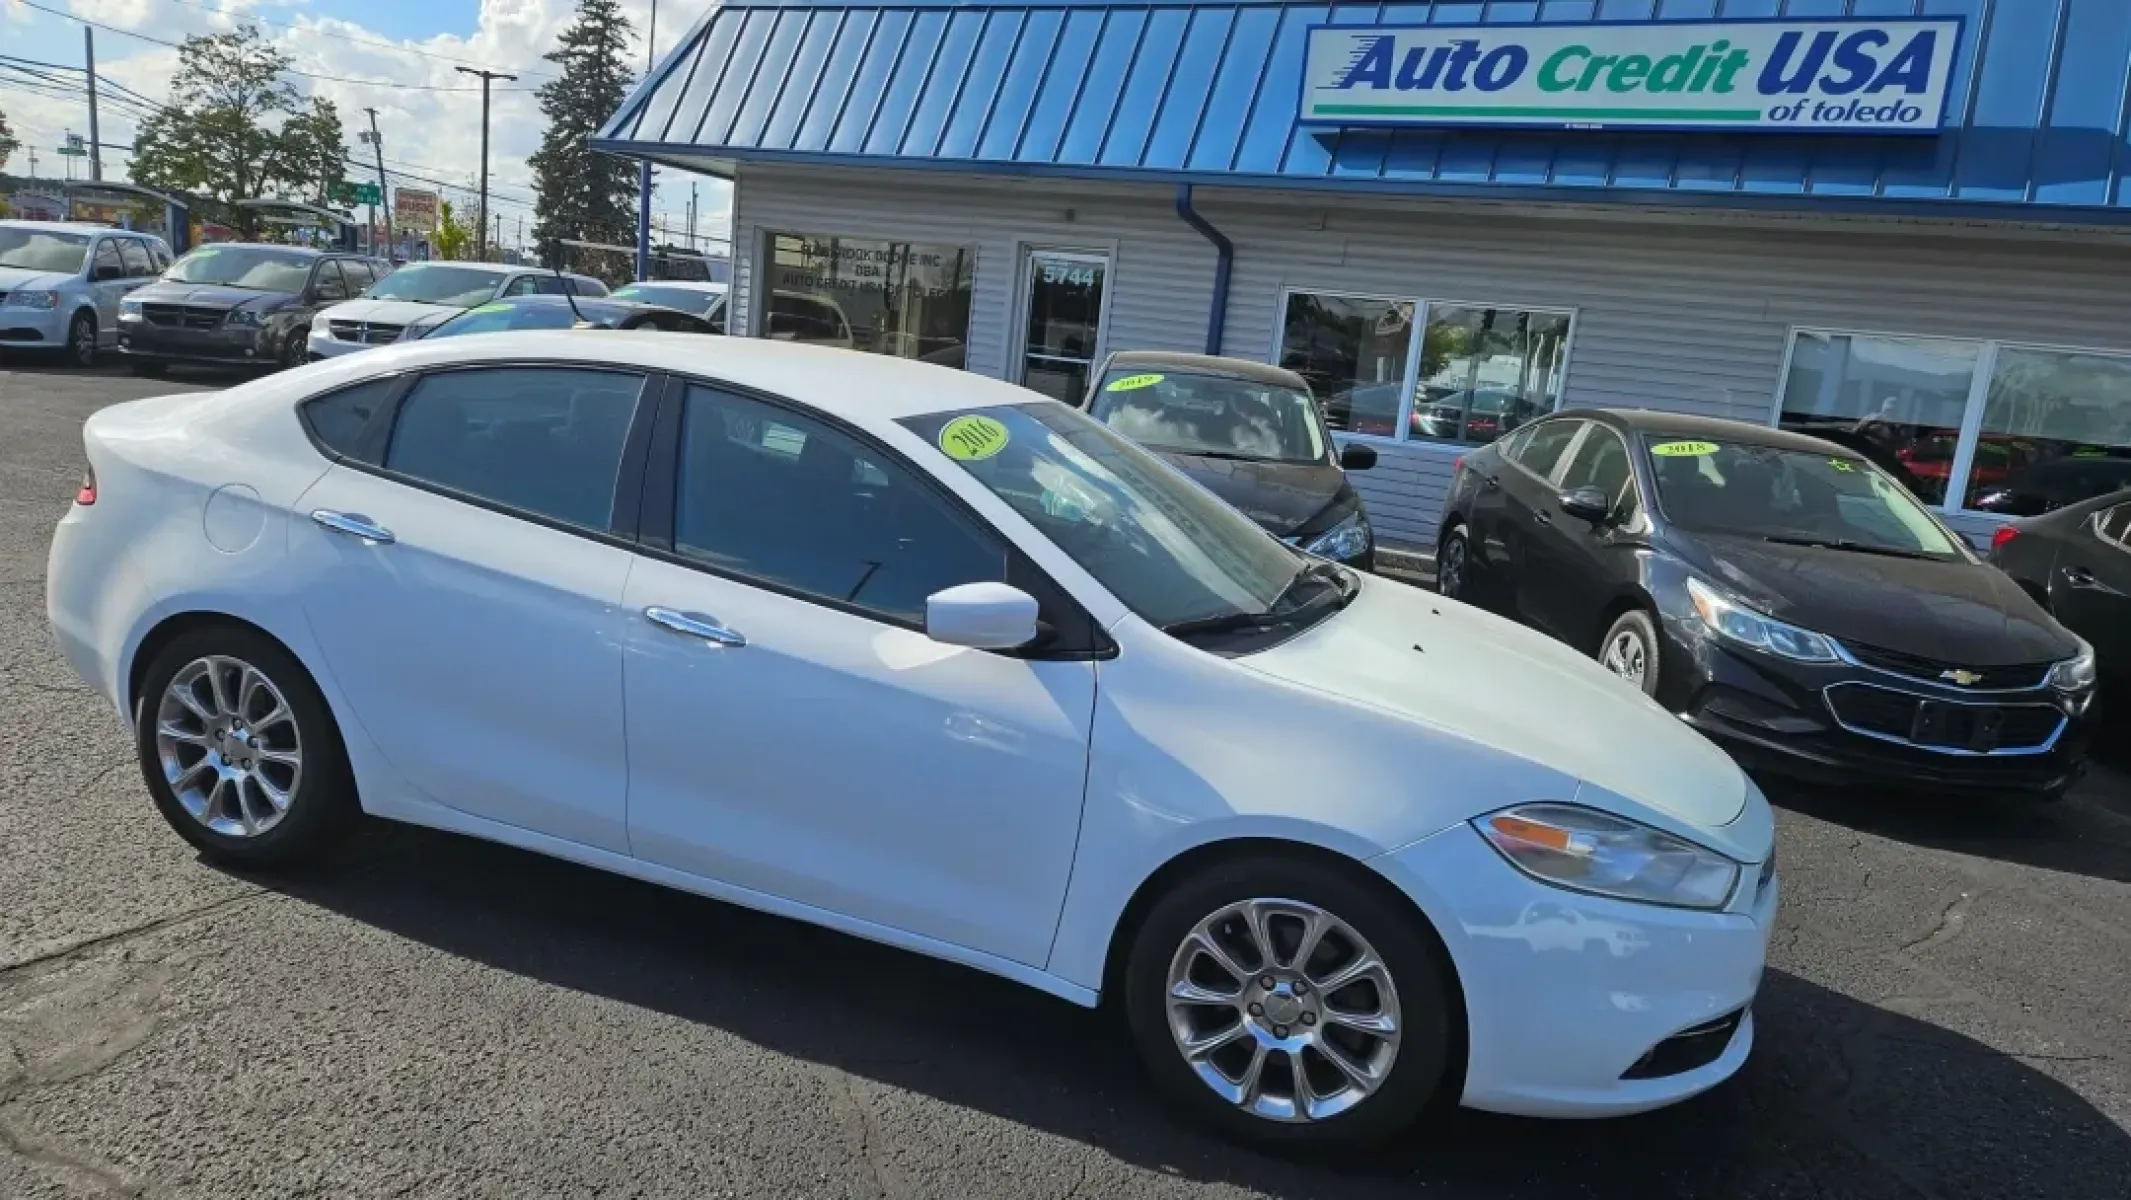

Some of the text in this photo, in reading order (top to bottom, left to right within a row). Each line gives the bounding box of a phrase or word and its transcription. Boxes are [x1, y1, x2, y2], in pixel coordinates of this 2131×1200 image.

[1316, 28, 1937, 96] Auto Credit USA
[1767, 99, 1923, 123] of toledo
[855, 264, 879, 277] DBA
[1043, 266, 1094, 287] 5744
[950, 418, 999, 457] 2016
